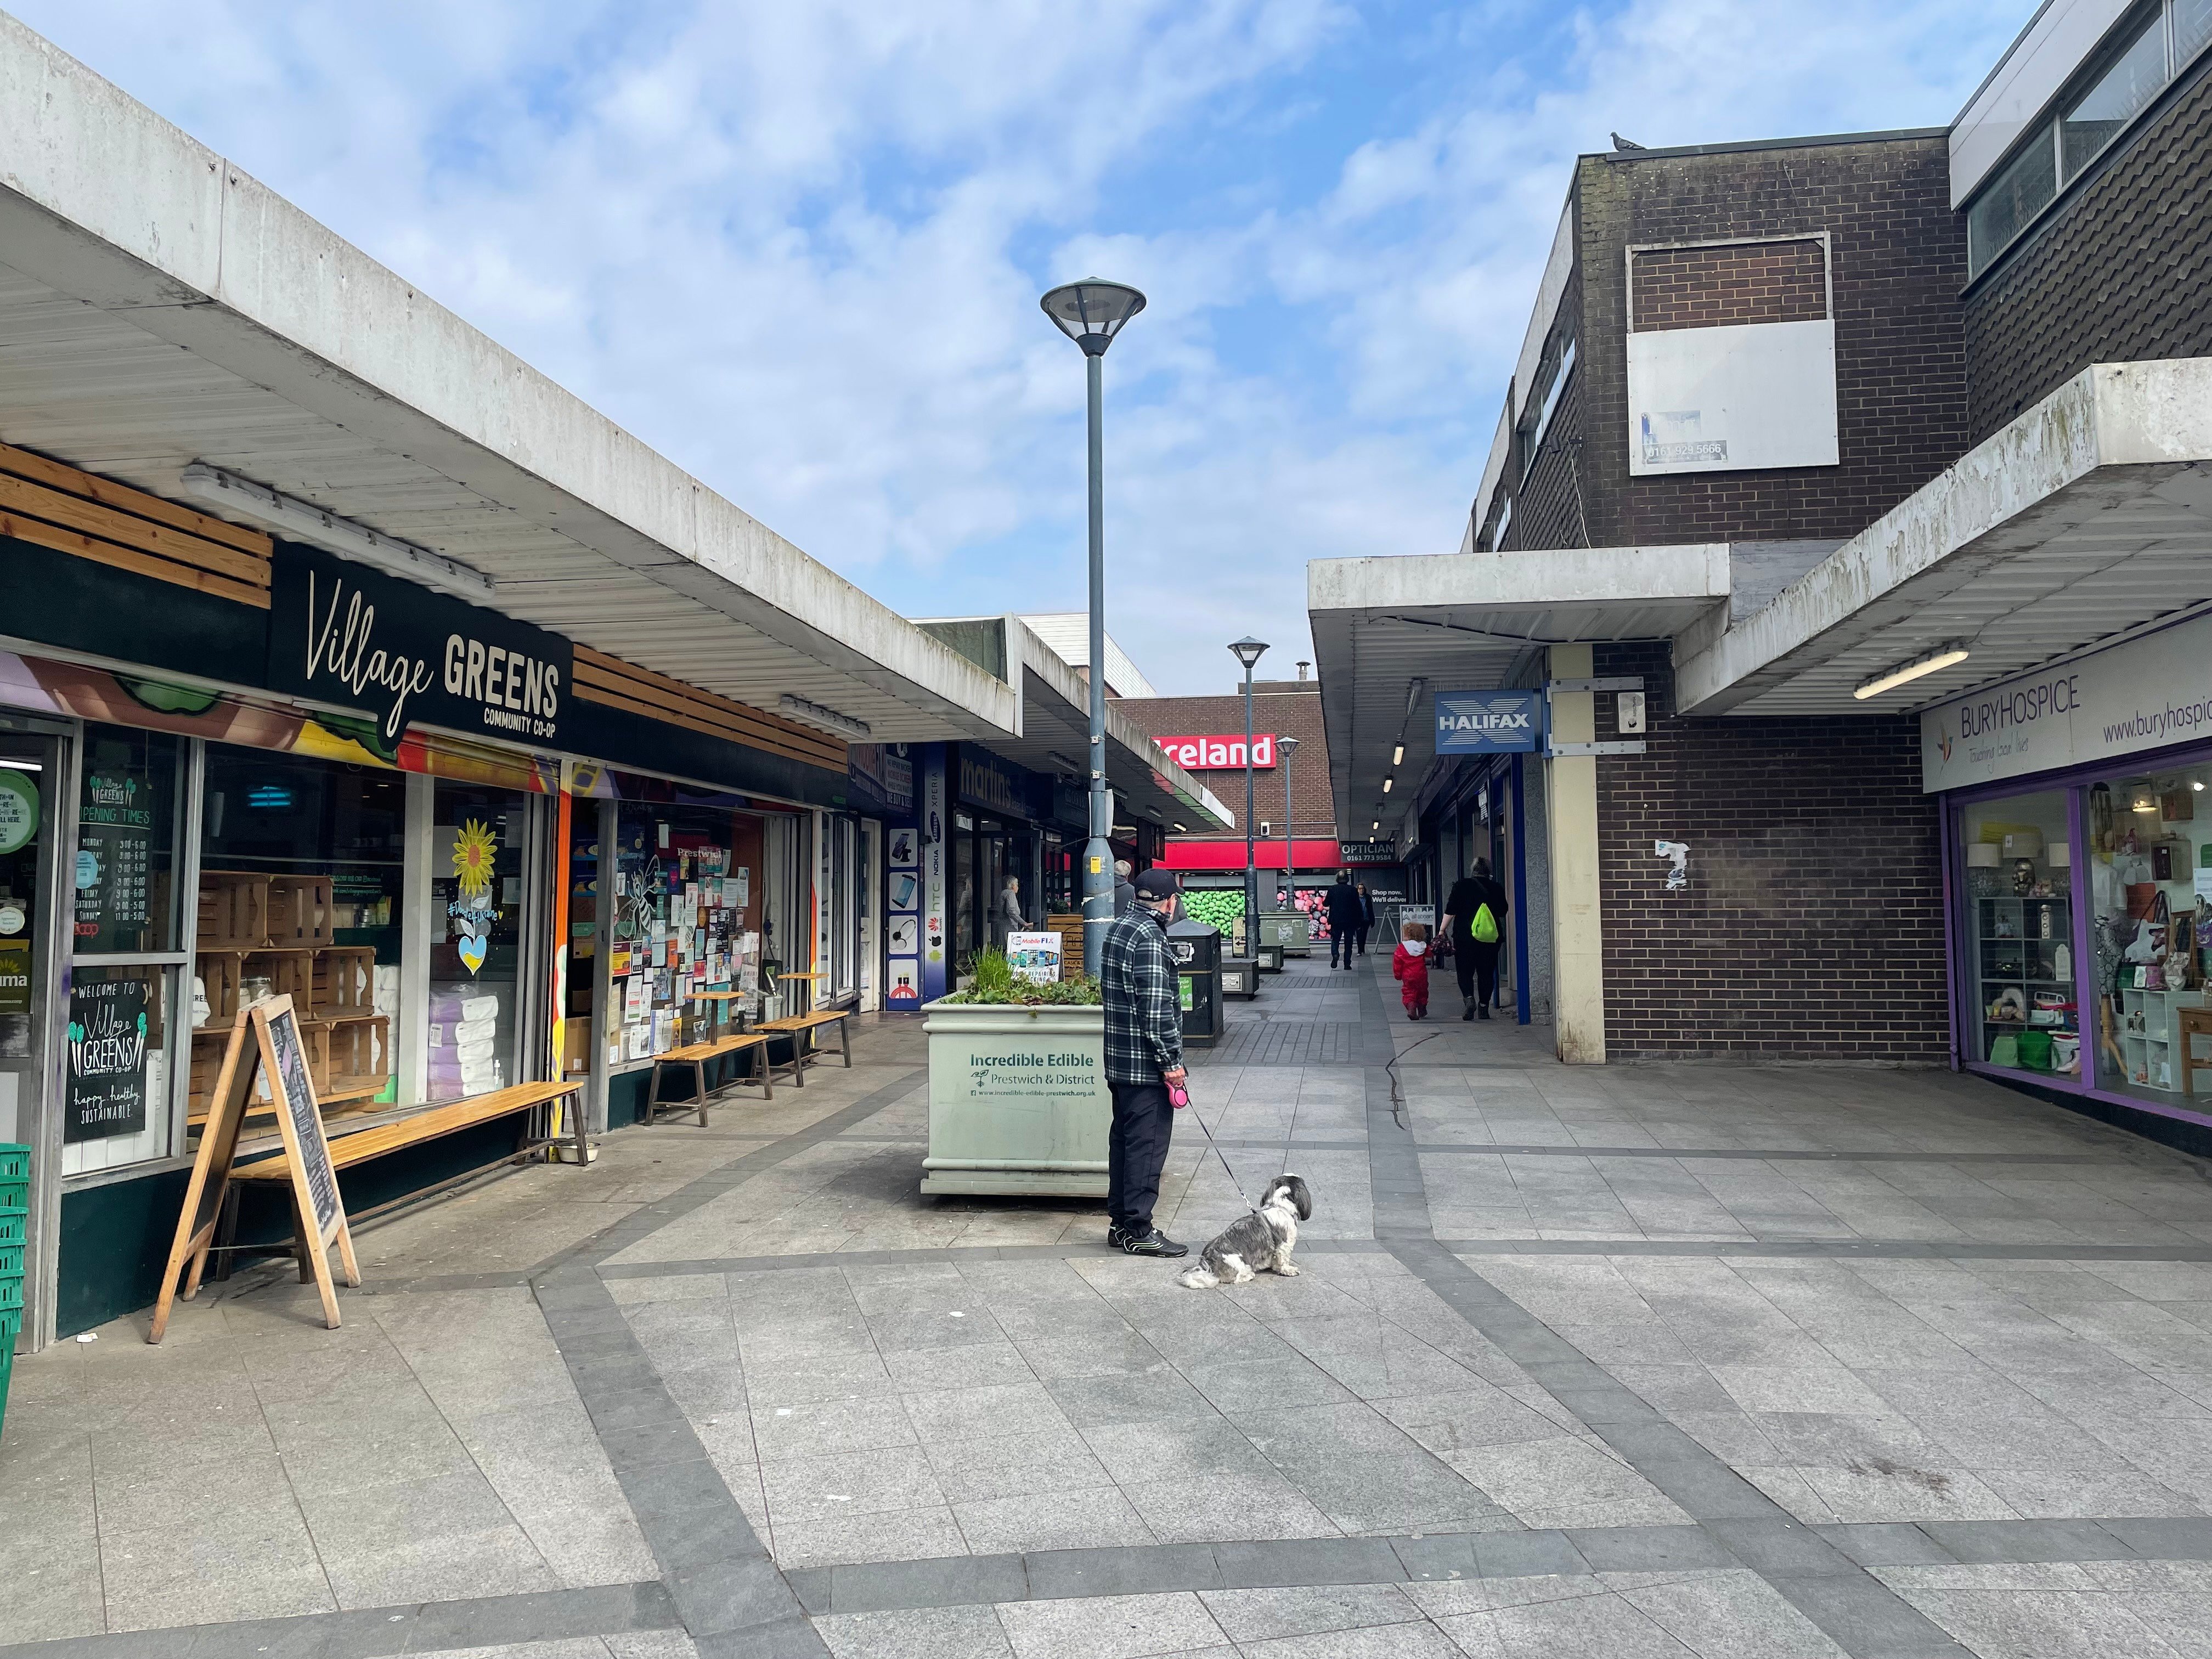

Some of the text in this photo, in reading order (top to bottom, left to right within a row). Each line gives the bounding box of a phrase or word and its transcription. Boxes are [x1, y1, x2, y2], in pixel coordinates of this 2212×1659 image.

[1675, 445, 1693, 454] 929
[1697, 444, 1721, 454] 5666
[308, 570, 558, 737] Village GREENS
[484, 707, 556, 738] COMMUNITY CO-OP
[1440, 714, 1530, 730] HALIFAX
[1154, 737, 1271, 766] celand
[1969, 739, 1995, 774] Touching
[961, 758, 1011, 809] martins
[100, 789, 124, 802] GREENS
[121, 808, 150, 824] TIMES
[82, 838, 103, 847] MONDAY
[1342, 844, 1394, 854] OPTICIAN
[81, 889, 98, 898] FRIDAY
[75, 899, 102, 909] SATURDAY
[79, 911, 98, 921] SUNDAY
[78, 982, 135, 999] WELCOME TO
[84, 1000, 132, 1047] Village
[83, 1037, 133, 1069] GREENS
[970, 1053, 1094, 1067] Incredible Edible
[83, 1067, 114, 1076] COMMUNITY
[991, 1074, 1095, 1085] Prestwich & District
